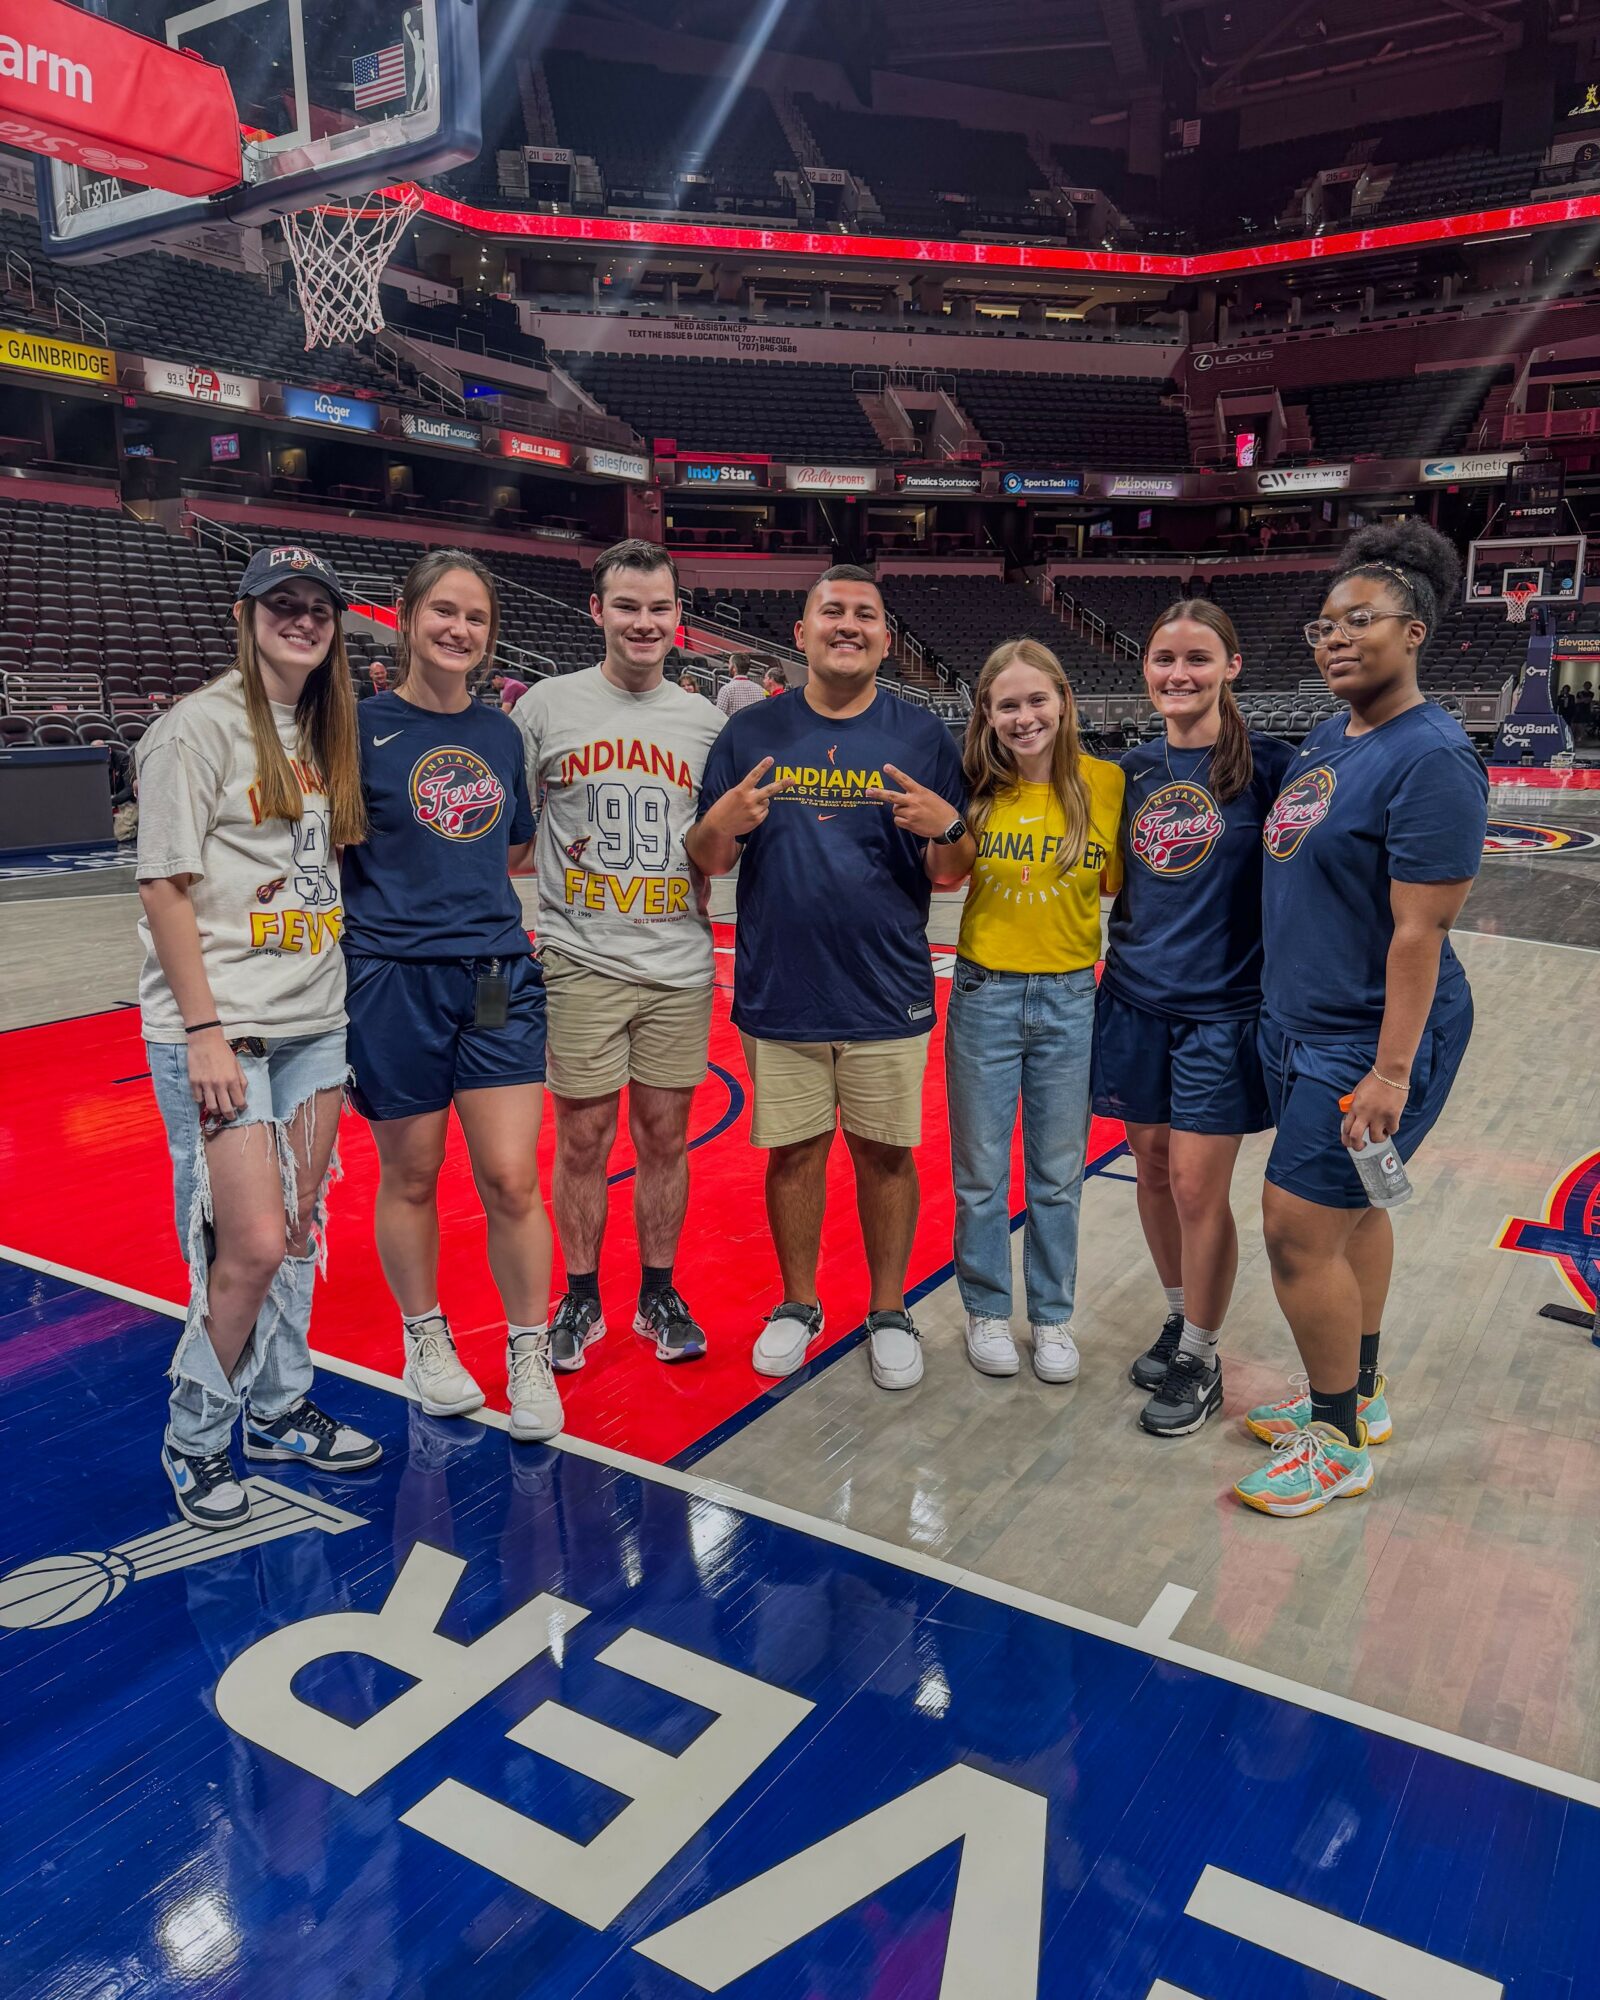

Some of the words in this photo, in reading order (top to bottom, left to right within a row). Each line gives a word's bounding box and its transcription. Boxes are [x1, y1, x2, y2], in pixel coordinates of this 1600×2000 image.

[528, 150, 540, 160] 211
[674, 321, 694, 331] NEED
[696, 323, 747, 333] ASSISTANCE?
[628, 330, 647, 338] TEXT
[648, 331, 662, 339] THE
[664, 332, 686, 340] ISSUE
[687, 332, 693, 340] &
[694, 333, 729, 342] LOCATION
[730, 334, 740, 342] TO
[741, 335, 792, 346] 707-TIMEOUT.
[8, 340, 110, 376] GAINBRIDGE
[1215, 350, 1274, 365] LEXUS
[166, 371, 185, 387] 93.5
[186, 365, 213, 388] the
[192, 385, 222, 403] fan
[222, 382, 240, 397] 107.5
[314, 394, 350, 424] Kroger
[417, 418, 450, 438] Ruoff
[450, 429, 480, 442] MORTGAGE
[520, 442, 543, 456] BELLE
[544, 446, 561, 459] TIRE
[592, 452, 643, 474] salesforce
[1461, 460, 1509, 473] Kinetic
[796, 468, 835, 488] Bally
[836, 473, 866, 485] SPORTS
[906, 475, 937, 487] Fanatics
[938, 476, 980, 490] Sportsbook
[1294, 471, 1318, 480] CITY
[1321, 469, 1349, 477] WIDE
[1023, 478, 1048, 490] Sports
[1048, 479, 1066, 488] Tech
[1066, 479, 1080, 489] HQ
[1134, 480, 1173, 491] DONUTS
[1522, 506, 1557, 516] TISSOT
[269, 550, 330, 577] CLARK
[1558, 638, 1600, 647] Elevance
[1503, 723, 1558, 736] KeyBank
[422, 755, 484, 777] INDIANA
[561, 738, 693, 799] INDIANA
[774, 766, 884, 788] INDIANA
[417, 770, 503, 822] Fever
[778, 785, 867, 798] ASKETBA
[1148, 791, 1206, 812] INDIANA
[1132, 806, 1221, 854] Fever
[976, 831, 1034, 862] DIANA
[1040, 835, 1105, 870] FER
[564, 867, 690, 915] FEVER
